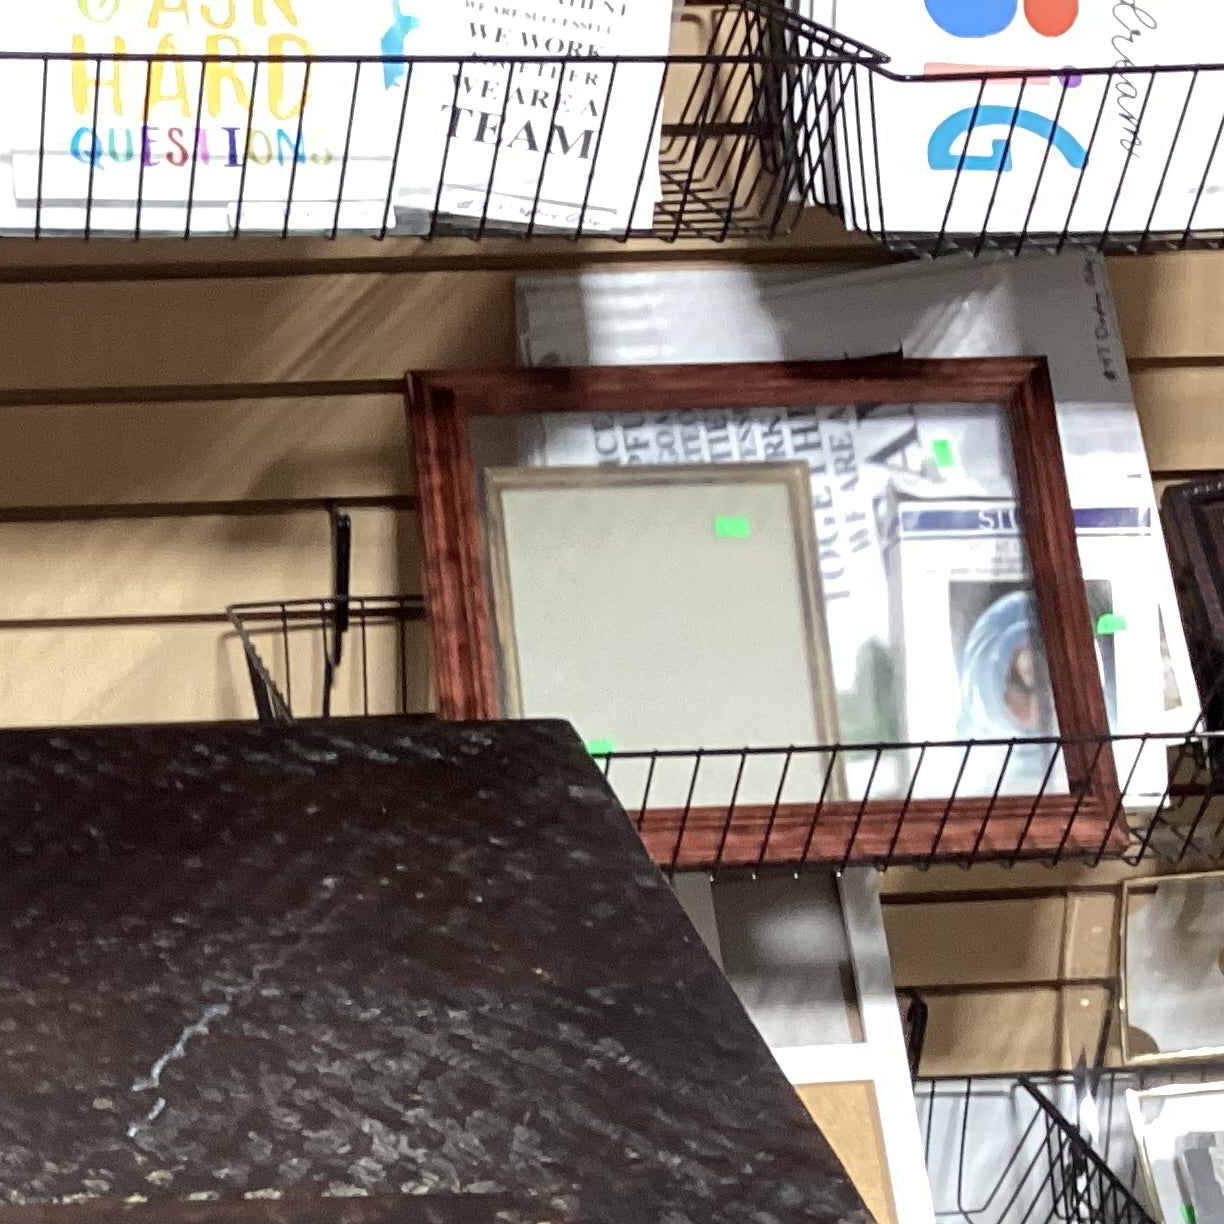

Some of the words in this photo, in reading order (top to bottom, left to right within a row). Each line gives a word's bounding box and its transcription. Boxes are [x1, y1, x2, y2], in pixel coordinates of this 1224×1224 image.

[469, 22, 509, 44] WE
[521, 31, 604, 58] WORK
[72, 34, 315, 120] HARD
[452, 73, 501, 100] WE
[507, 87, 574, 113] ARE
[580, 98, 599, 117] A
[440, 104, 601, 160] TEAM
